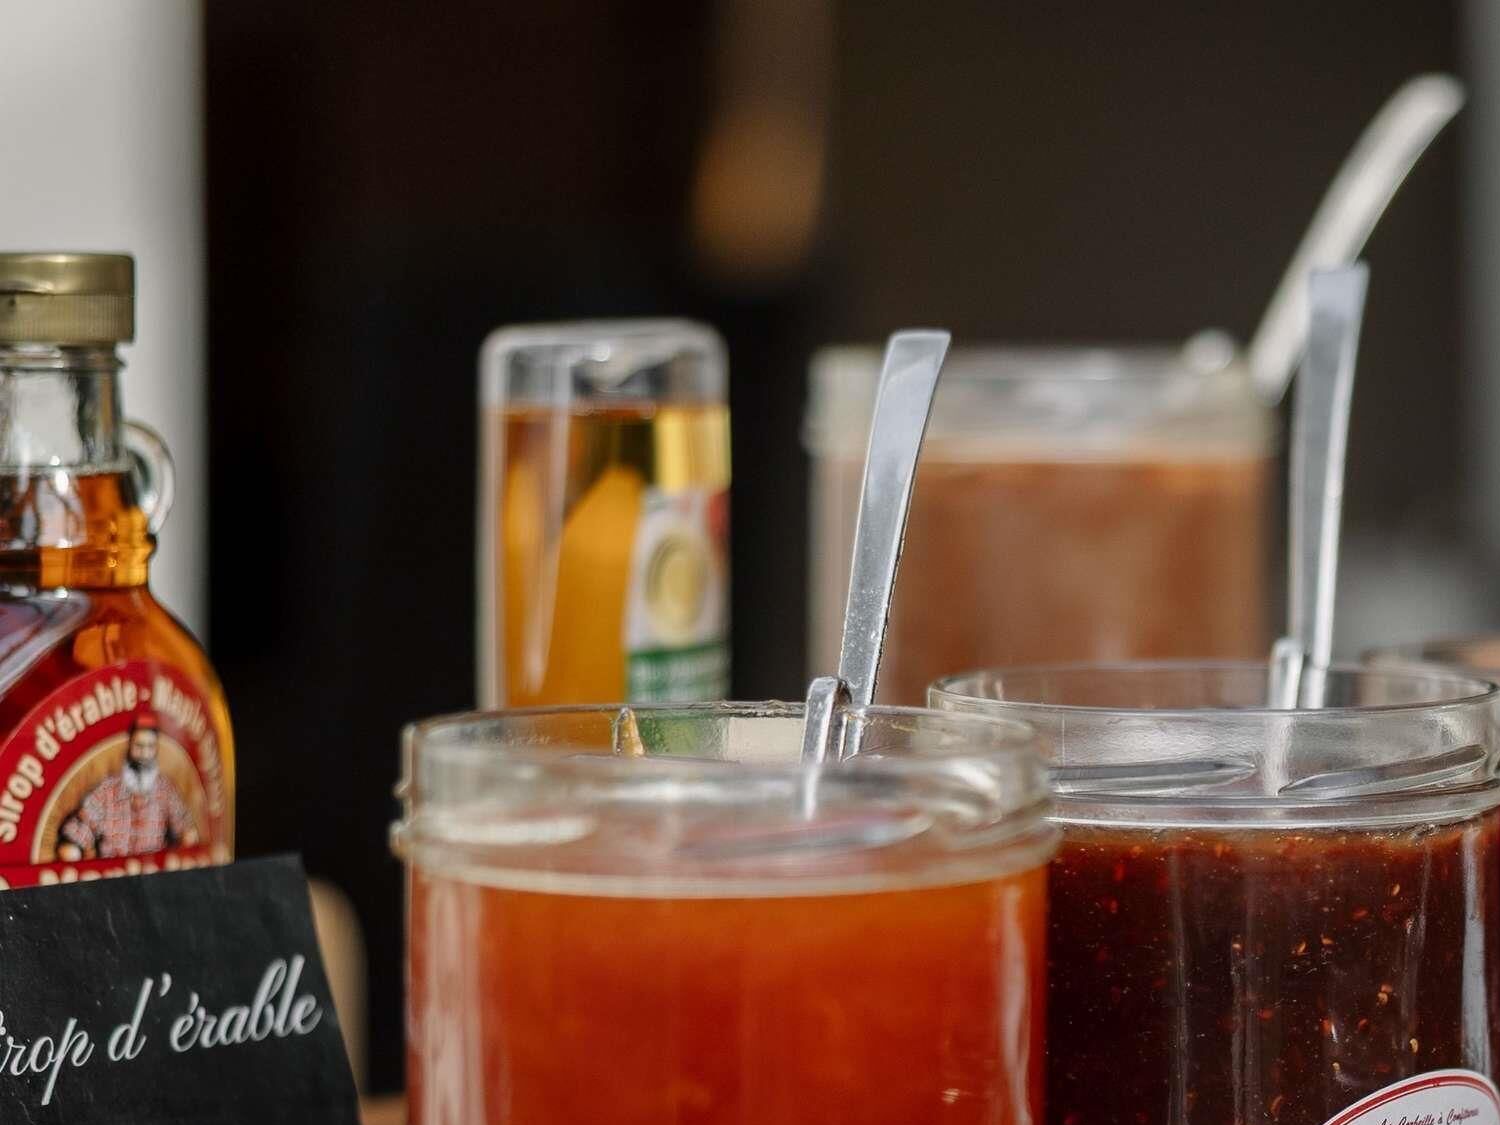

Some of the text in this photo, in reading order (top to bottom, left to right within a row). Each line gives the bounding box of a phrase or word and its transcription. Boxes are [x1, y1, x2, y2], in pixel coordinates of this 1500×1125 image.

[35, 675, 138, 761] d'érable
[0, 954, 323, 1106] rop d'érable
[1437, 1112, 1443, 1125] à
